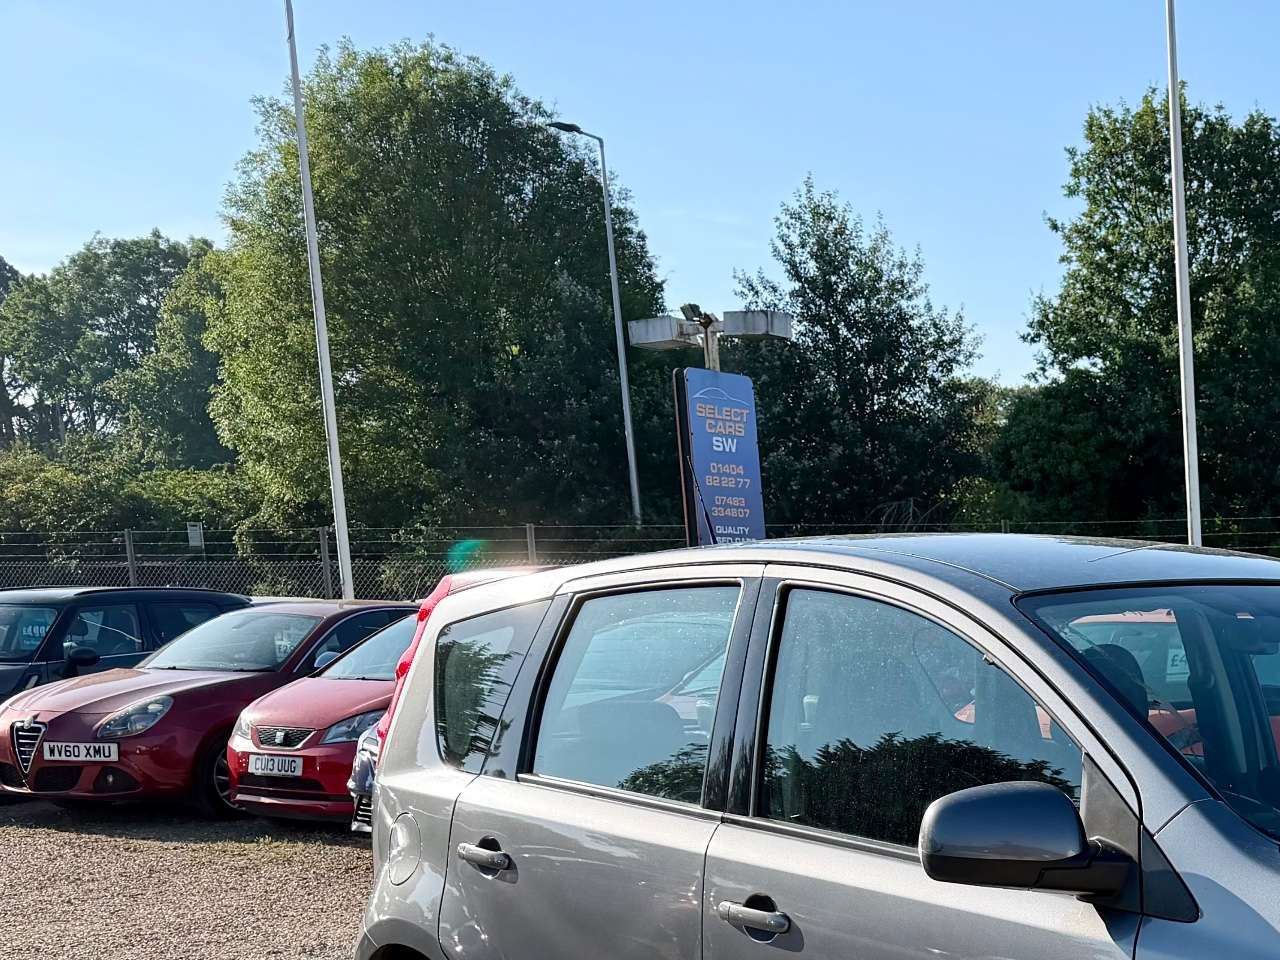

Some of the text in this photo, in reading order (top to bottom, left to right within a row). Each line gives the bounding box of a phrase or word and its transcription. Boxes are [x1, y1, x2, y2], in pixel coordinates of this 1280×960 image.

[696, 402, 749, 422] SELECT
[706, 419, 745, 437] CARS
[712, 436, 737, 453] SW
[710, 463, 744, 475] 01404
[715, 525, 750, 535] QUALITY
[48, 744, 112, 758] WV60 XMU
[277, 758, 297, 773] UUG
